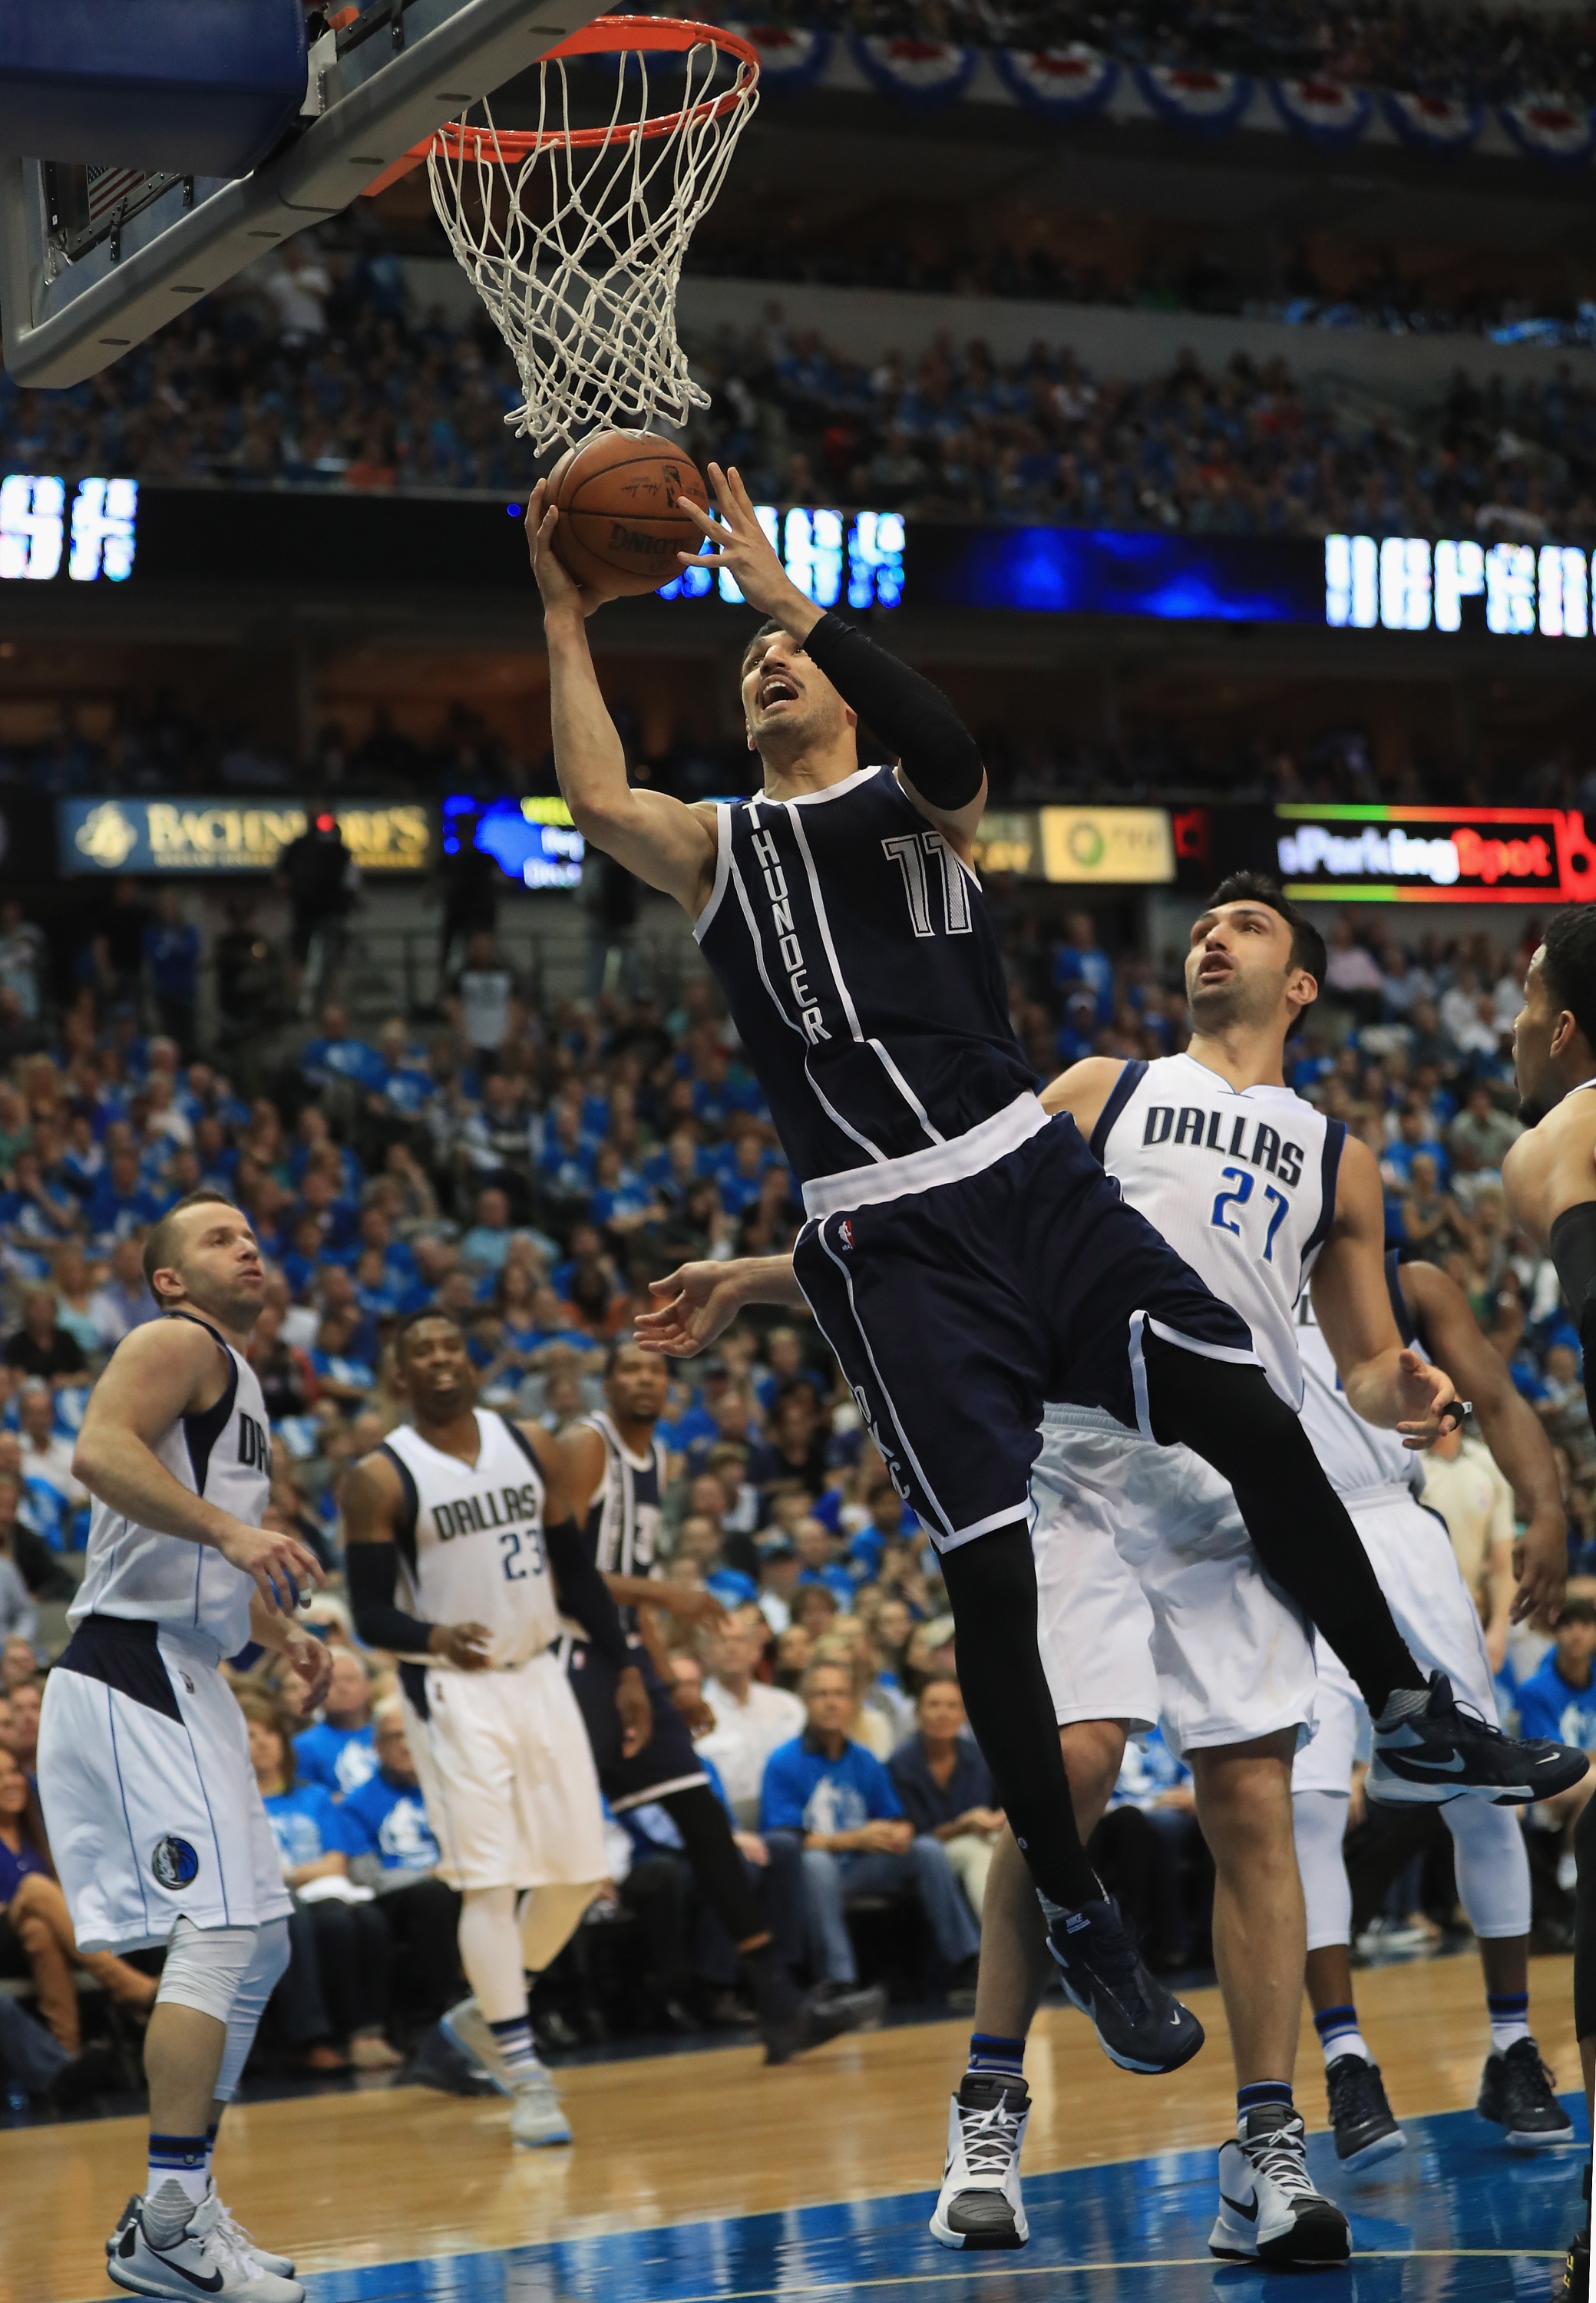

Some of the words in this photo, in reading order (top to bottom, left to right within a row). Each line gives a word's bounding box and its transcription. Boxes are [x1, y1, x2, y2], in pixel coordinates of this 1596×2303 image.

[742, 800, 832, 1046] THUNDER
[881, 830, 973, 938] 11
[1141, 1105, 1305, 1189] DALLAS
[1210, 1165, 1290, 1264] 27
[431, 1482, 537, 1542] DALLAS
[499, 1527, 544, 1583] 23
